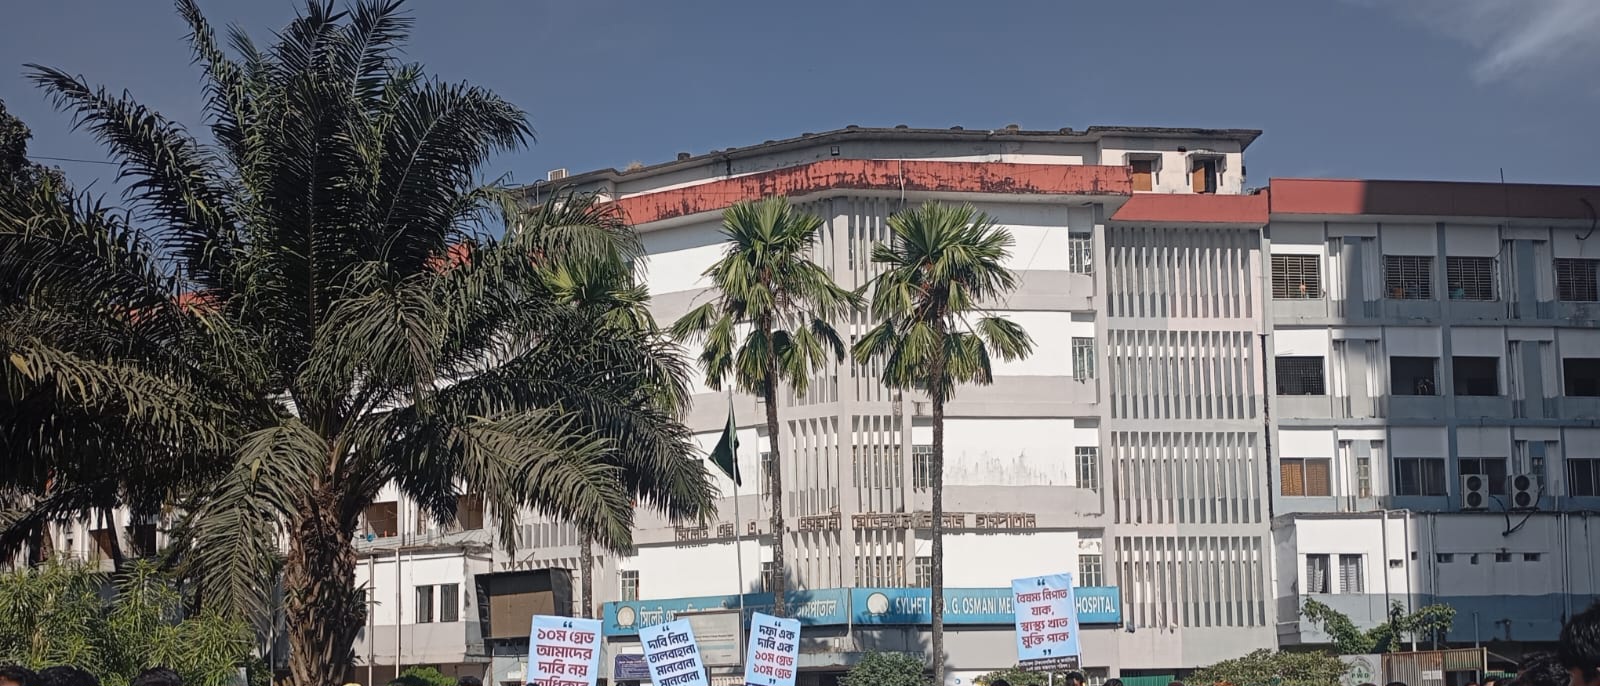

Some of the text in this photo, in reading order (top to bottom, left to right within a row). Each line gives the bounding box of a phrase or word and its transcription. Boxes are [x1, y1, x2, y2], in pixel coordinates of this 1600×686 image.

[976, 512, 1036, 529] হাসপাতাল
[1016, 588, 1068, 604] বৈষম্য নিপাত
[1075, 596, 1116, 613] HOSPITAL
[895, 597, 927, 614] SYLHET
[962, 597, 997, 614] OSMANI
[759, 625, 796, 641] দফা এক
[1020, 617, 1068, 632] স্বাস্থ্য খাত
[537, 628, 596, 645] ১০ম গ্রেড
[647, 634, 668, 650] দাবি
[668, 632, 690, 645] নিয়ে
[757, 637, 794, 653] দাবি এক
[1021, 631, 1070, 649] মুক্তি পাক
[536, 645, 593, 661] আমাদের
[648, 644, 696, 664] তালবাহানা
[755, 651, 794, 667] ১০ম গ্রেড
[538, 658, 588, 678] দাবি নয়
[656, 658, 697, 676] মানবোনা
[753, 663, 792, 680] ১০ম গ্রেড
[659, 670, 700, 686] মানবোনা
